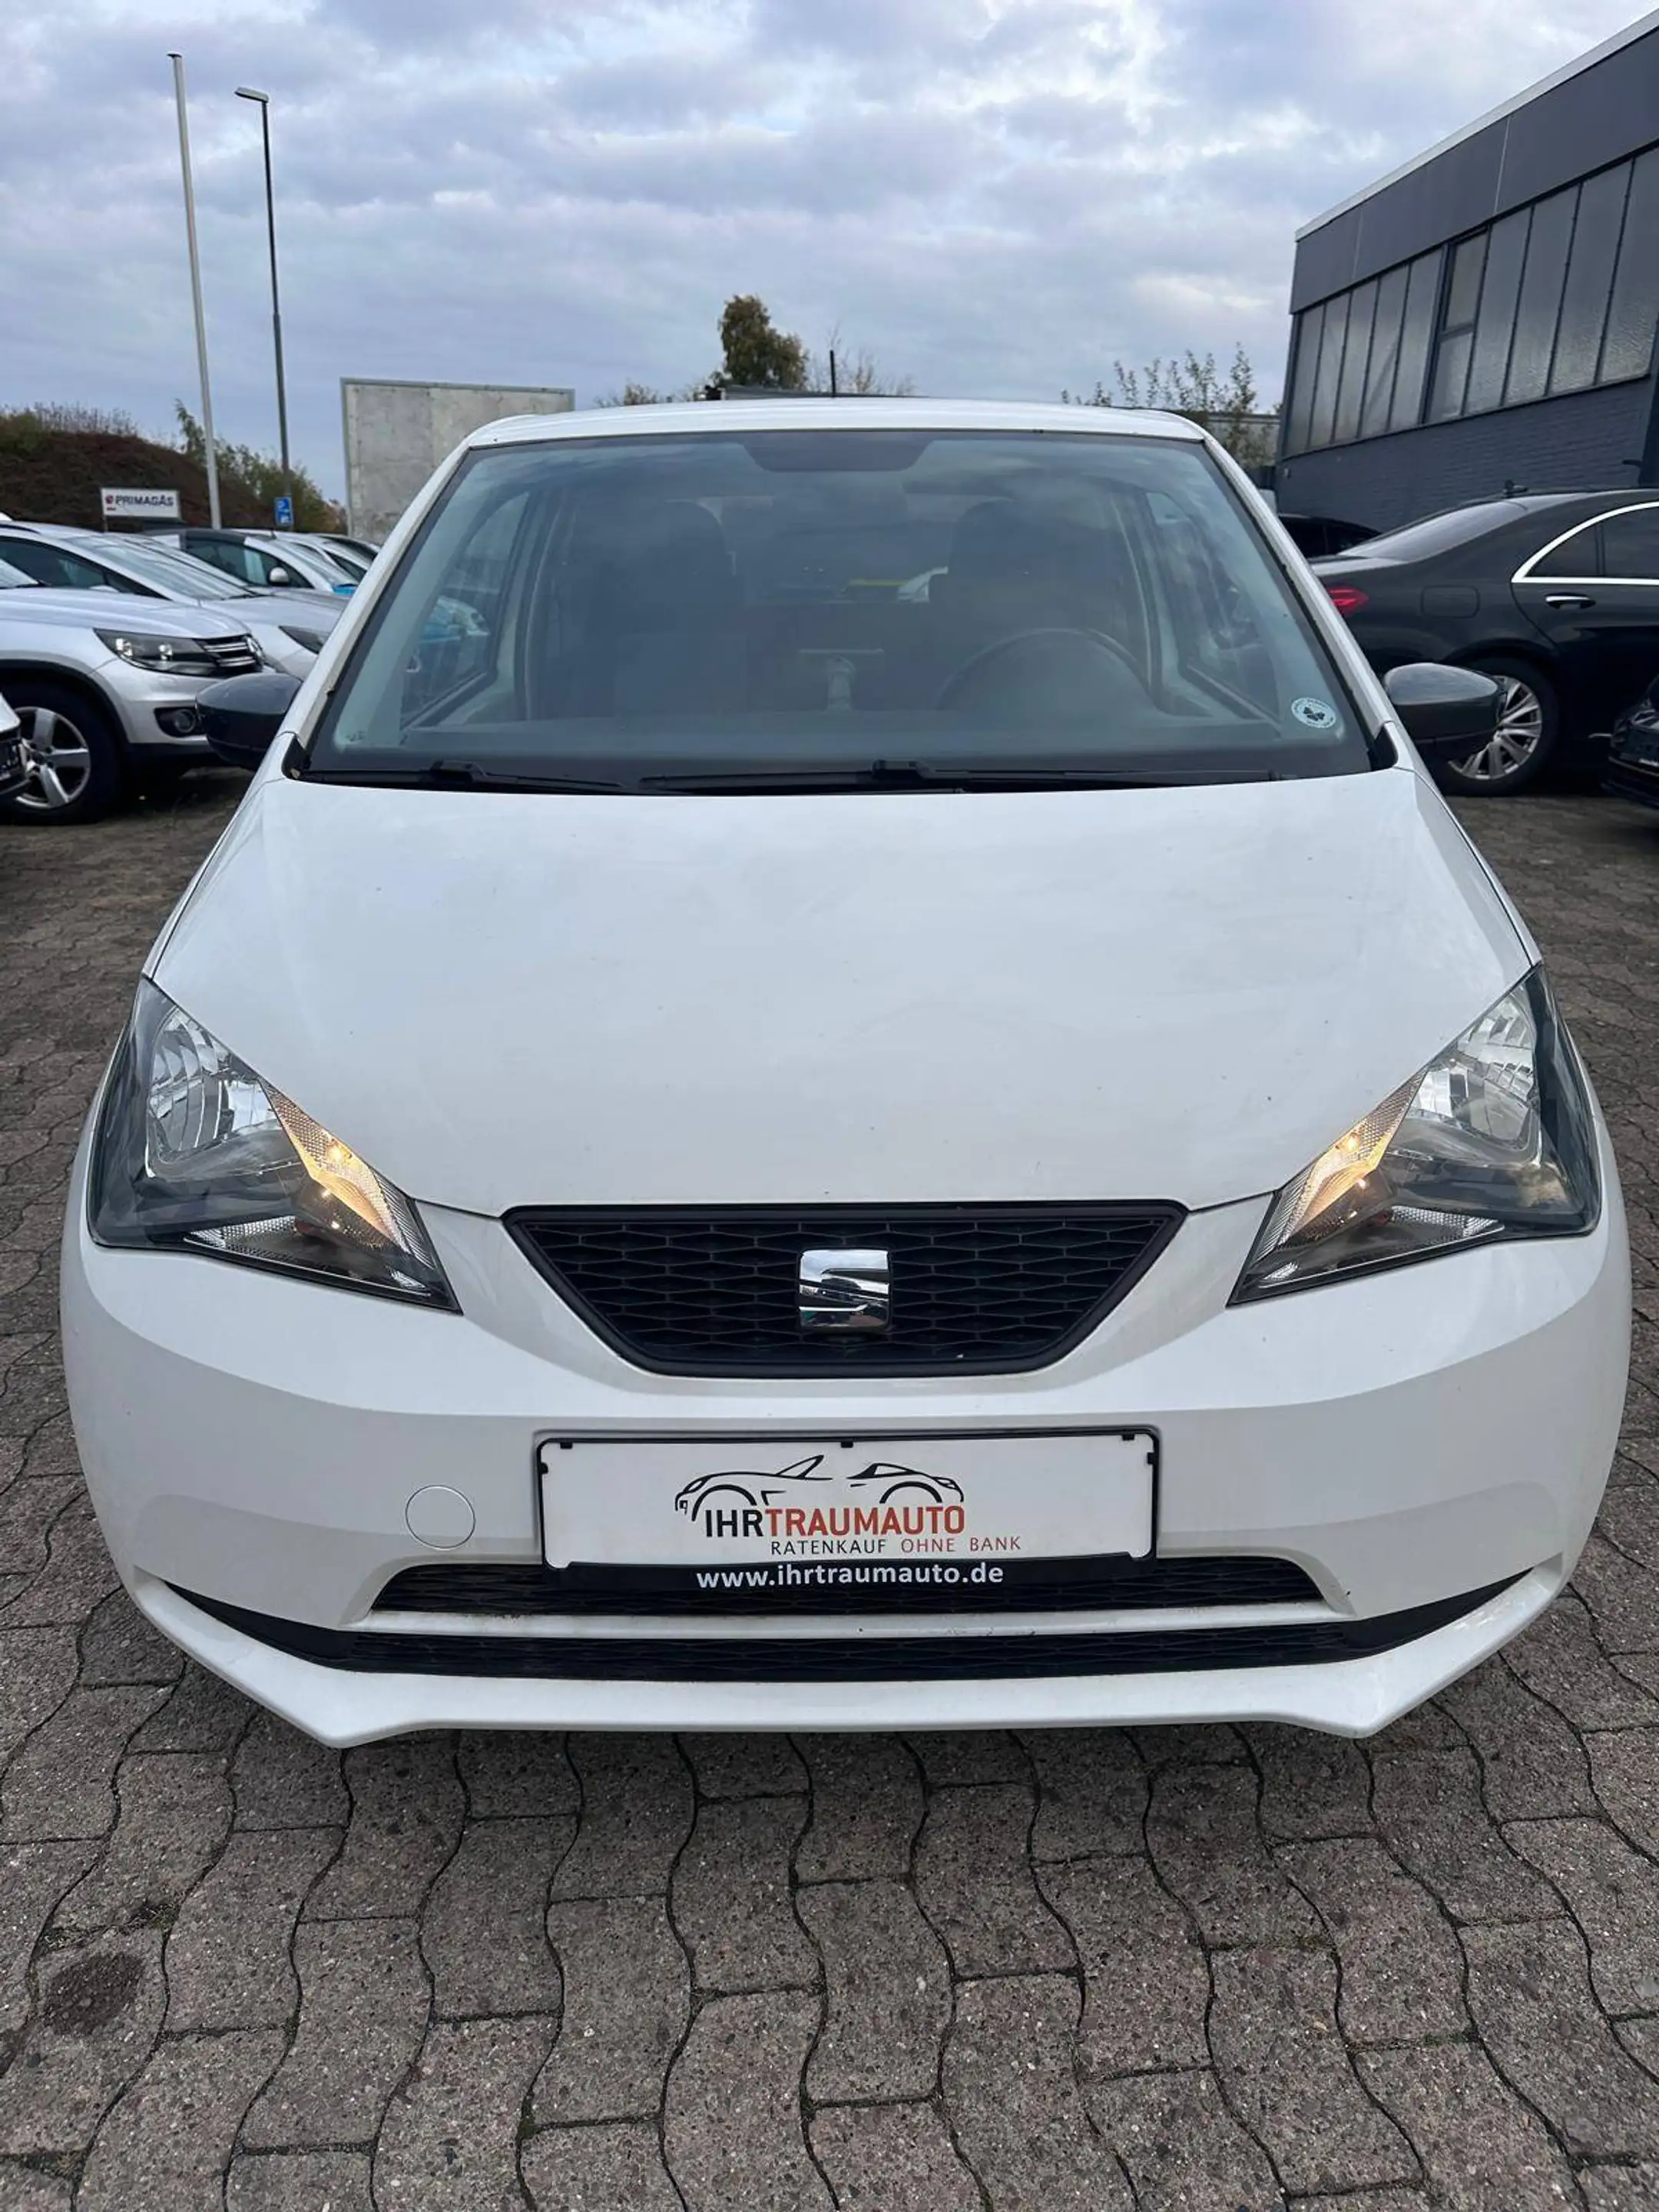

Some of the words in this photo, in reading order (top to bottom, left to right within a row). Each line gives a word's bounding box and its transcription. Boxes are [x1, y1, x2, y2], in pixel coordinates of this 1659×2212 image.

[705, 1505, 965, 1538] IHRTRAUMAUTO
[770, 1539, 887, 1555] RATENKAUF
[900, 1538, 955, 1553] OHNE
[969, 1536, 1022, 1551] BANK
[696, 1562, 1004, 1588] www.ihrtraumauto.de
